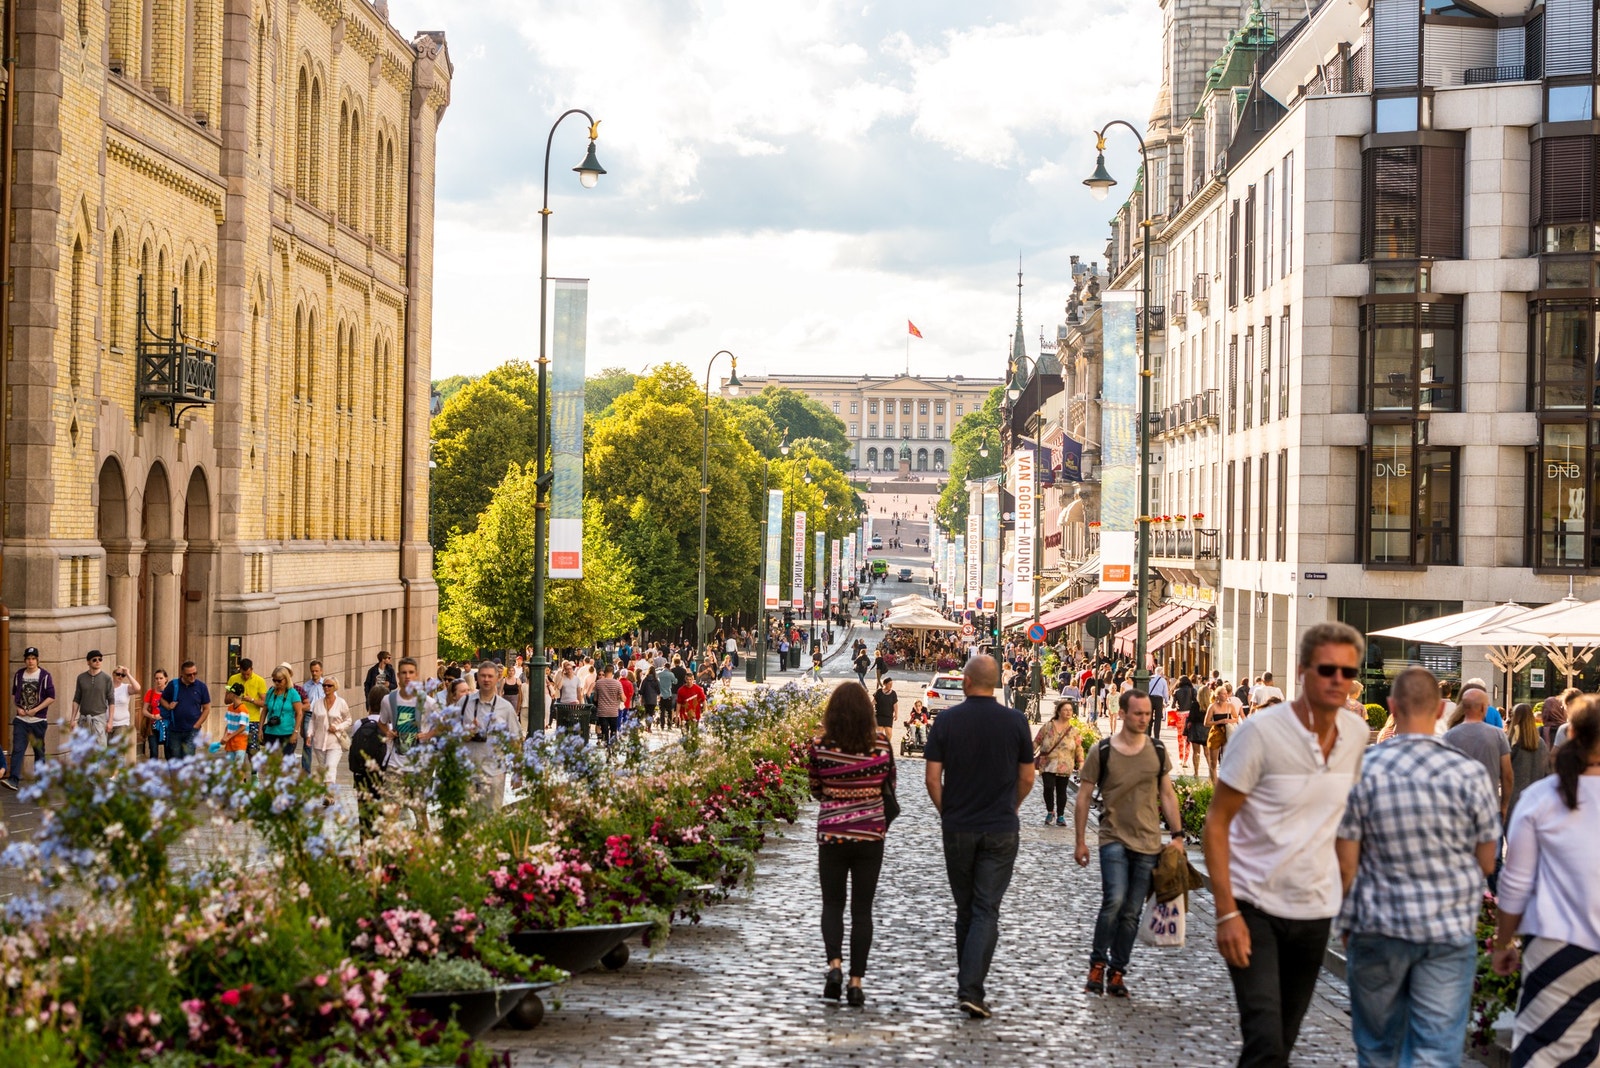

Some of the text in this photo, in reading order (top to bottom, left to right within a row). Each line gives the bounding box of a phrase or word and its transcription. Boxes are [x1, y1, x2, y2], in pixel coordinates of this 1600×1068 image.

[1018, 456, 1031, 481] VAN
[1376, 463, 1407, 477] DNB
[1547, 464, 1581, 479] DNB
[970, 518, 978, 532] VAN
